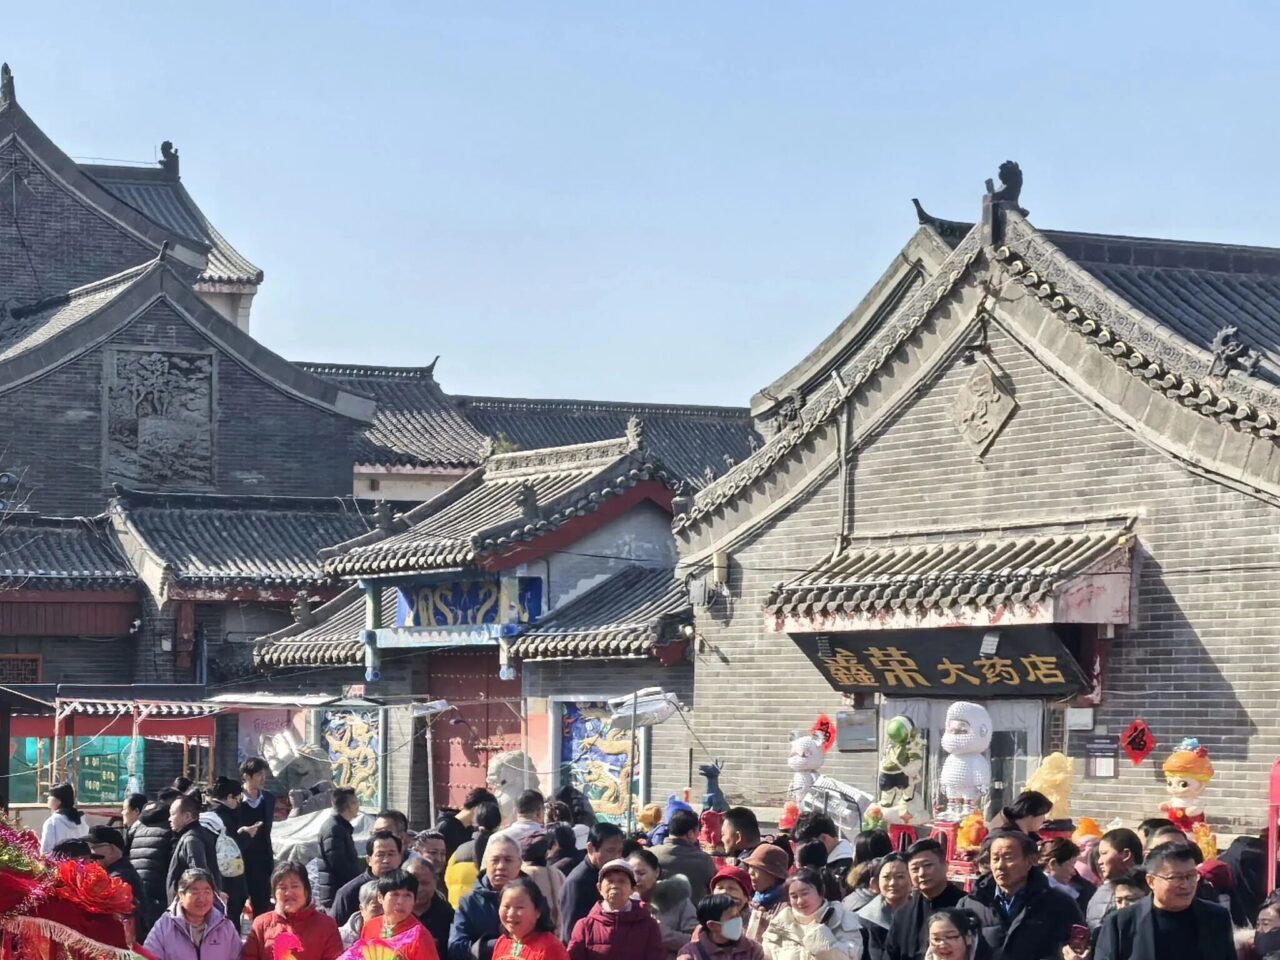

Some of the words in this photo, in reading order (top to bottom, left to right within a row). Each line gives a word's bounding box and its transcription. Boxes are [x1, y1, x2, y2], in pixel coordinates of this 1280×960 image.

[821, 646, 1066, 688] 鑫荣大药店
